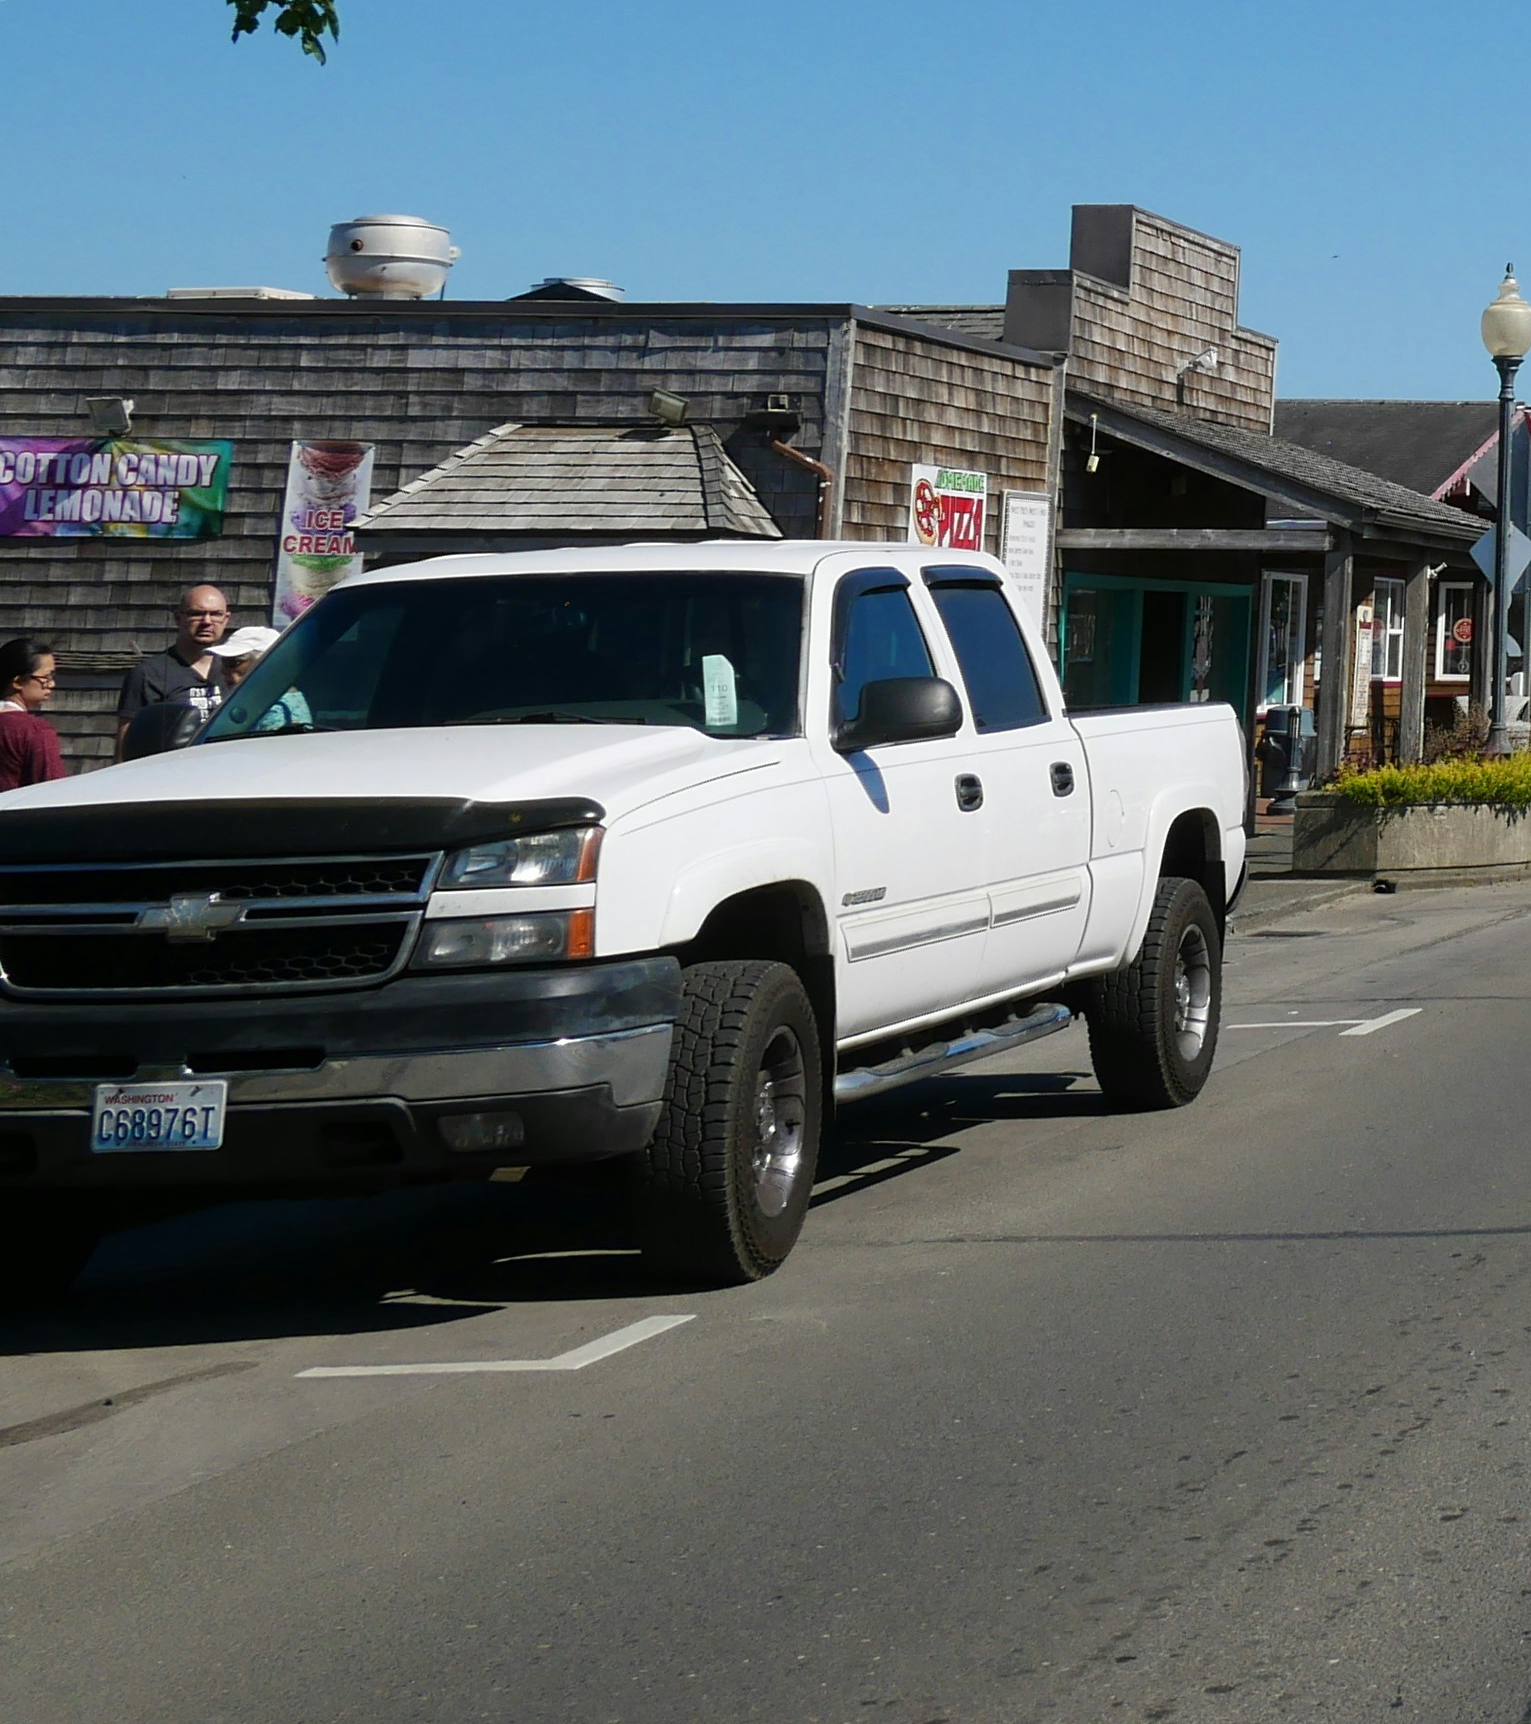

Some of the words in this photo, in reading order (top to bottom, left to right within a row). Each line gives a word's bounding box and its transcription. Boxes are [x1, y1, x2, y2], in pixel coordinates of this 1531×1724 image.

[0, 451, 113, 485] COTTON
[117, 452, 220, 487] CANDY
[24, 489, 179, 524] LEMONADE
[305, 510, 343, 530] ICE
[938, 495, 983, 551] PIZZA
[283, 535, 359, 554] CREAM
[104, 1094, 175, 1105] WASHINGTON
[101, 1106, 216, 1142] C68976T
